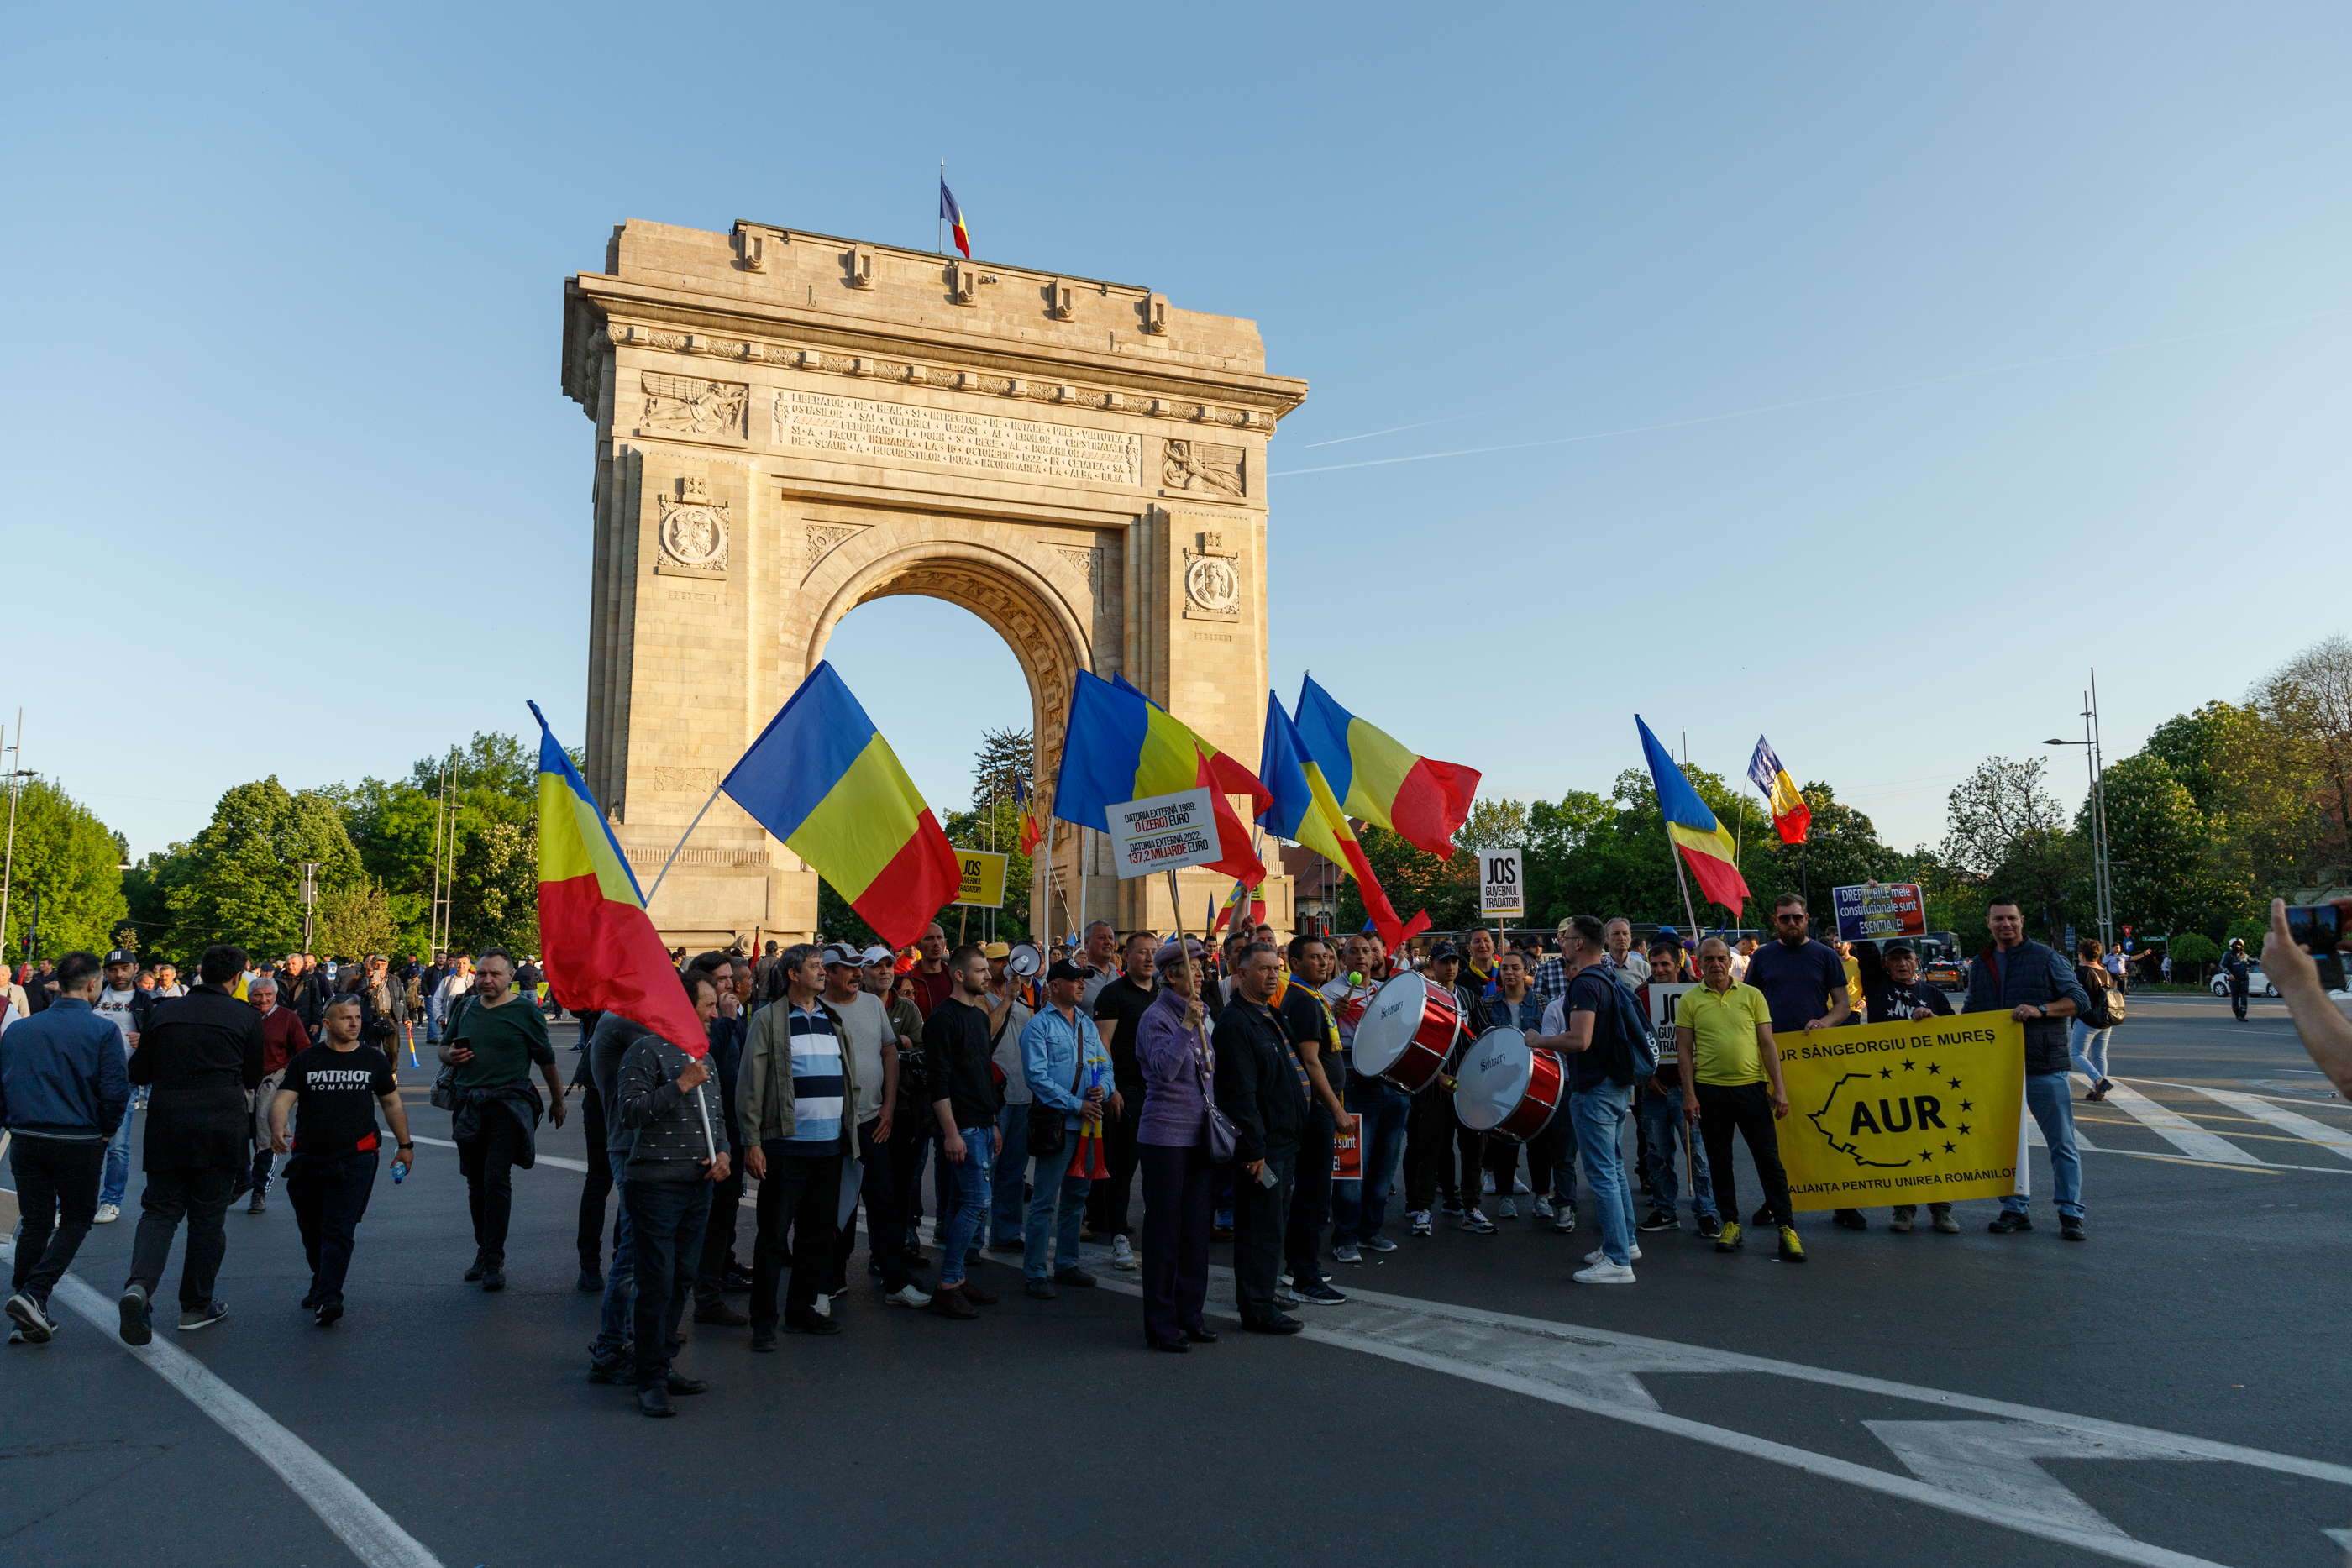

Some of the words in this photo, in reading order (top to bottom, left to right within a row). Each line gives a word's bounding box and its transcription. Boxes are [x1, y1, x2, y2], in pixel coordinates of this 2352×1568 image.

[792, 393, 844, 408] LIBERATOR
[854, 401, 867, 411] DE
[877, 404, 903, 415] NEAM
[990, 418, 1002, 428] DE
[1011, 421, 1045, 433] HOTARE
[1053, 427, 1073, 437] PRIN
[1082, 430, 1124, 443] VIRTUTEA
[792, 404, 843, 418] OSTASILOR
[889, 416, 931, 429] VREDNICI
[945, 423, 978, 435] URMASI
[992, 429, 1001, 438] AI
[1015, 432, 1051, 444] EROILOR
[841, 421, 894, 435] FERDINAND
[920, 431, 945, 442] DOMN
[975, 438, 999, 448] REGE
[1009, 442, 1021, 451] AL
[792, 436, 805, 446] DE
[815, 439, 846, 451] SCAUN
[856, 444, 864, 453] A
[873, 446, 941, 462] BUCURESTILOR
[950, 455, 973, 466] DUPA
[981, 459, 1042, 473] INCORONAREA
[1050, 466, 1062, 476] LA
[830, 430, 859, 442] FACUT
[869, 435, 916, 448] INTRAREA
[925, 442, 938, 451] LA
[947, 444, 956, 453] 16
[966, 447, 1014, 459] OCTOMBRIE
[1023, 453, 1041, 463] 1922
[1050, 457, 1059, 465] IN
[1068, 459, 1105, 471] CETATEA
[1113, 465, 1124, 473] SA
[1124, 810, 1150, 823] DATORIA
[1150, 804, 1177, 818] EXTERNĂ
[1179, 802, 1197, 812] 1989:
[1169, 812, 1190, 826] EURO
[1128, 850, 1151, 864] 137,2
[1151, 843, 1188, 860] MILIARDE
[1187, 839, 1209, 853] EURO
[1130, 840, 1155, 852] DATORIA
[1155, 833, 1183, 847] EXTERNĂ
[1183, 831, 1202, 842] 2022:
[963, 860, 982, 876] JOS
[1487, 858, 1516, 884] JOS
[962, 877, 982, 885] UVERNUL
[1486, 886, 1519, 896] GUVERNUL
[1842, 886, 1890, 902] DREPTURILE
[1891, 885, 1911, 898] mele
[1840, 899, 1898, 918] constituționale
[1899, 899, 1917, 912] sunt
[1859, 918, 1905, 936] ESENȚIALE!
[1380, 1001, 1403, 1020] Schwarz
[1660, 994, 1682, 1025] JO
[1801, 1038, 1906, 1059] SÂNGEORGIU
[1911, 1035, 1933, 1048] DE
[1937, 1029, 1995, 1045] MUREȘ
[1480, 1053, 1506, 1073] Schwarz
[307, 1070, 372, 1084] PATRIOT
[1850, 1095, 1947, 1136] AUR
[1788, 1182, 1840, 1194] ALIANȚA
[1842, 1179, 1891, 1191] PENTRU
[1895, 1175, 1942, 1187] UNIREA
